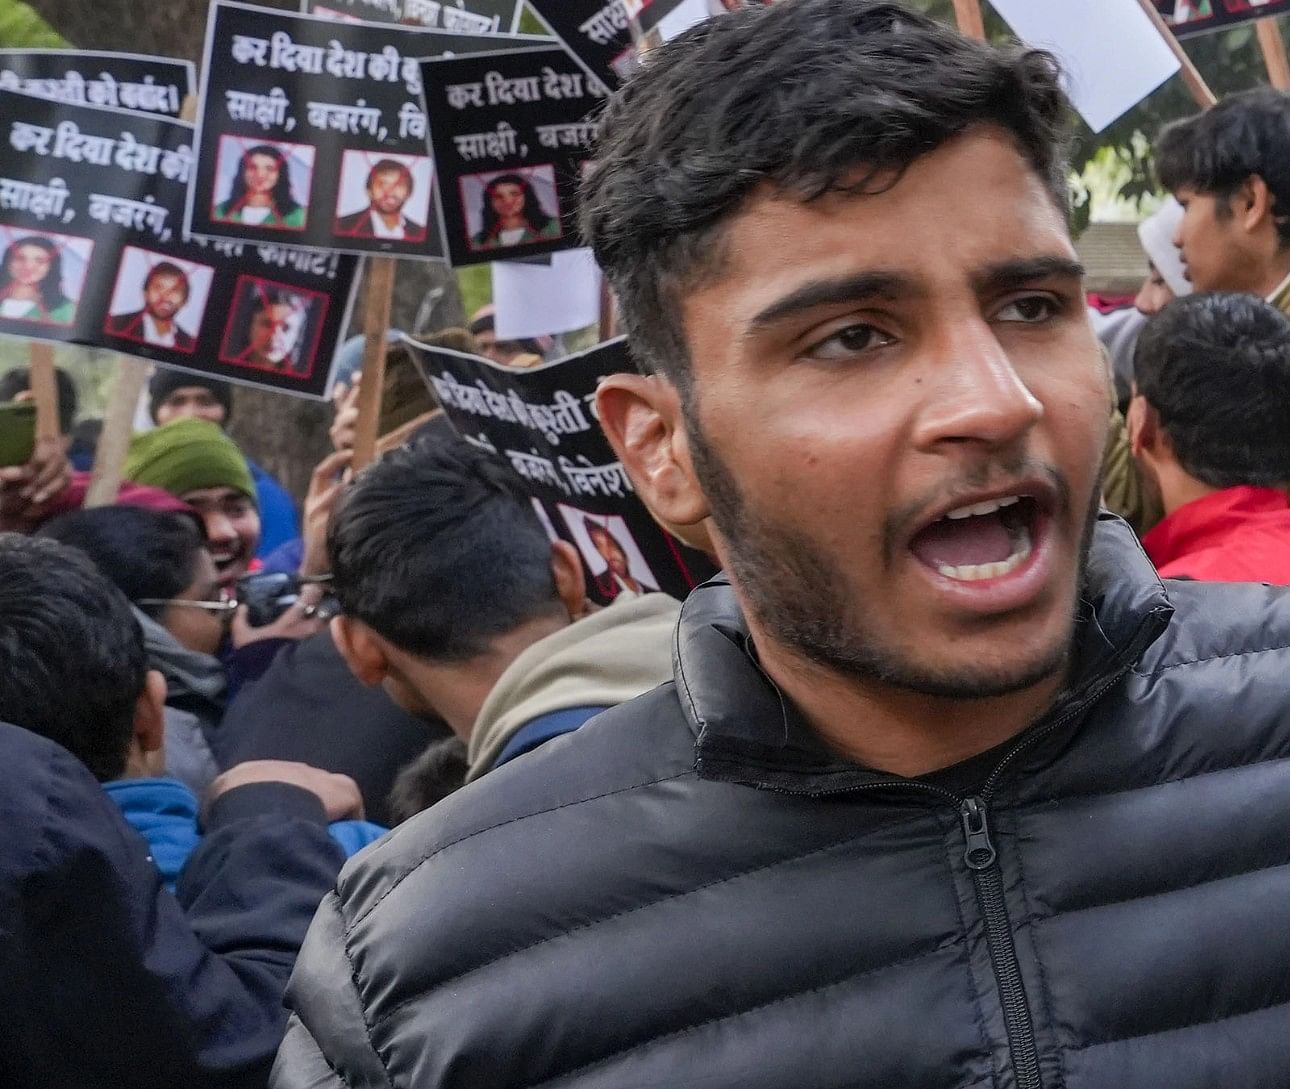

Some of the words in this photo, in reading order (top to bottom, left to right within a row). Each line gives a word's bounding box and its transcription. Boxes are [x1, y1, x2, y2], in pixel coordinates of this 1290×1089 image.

[232, 34, 270, 67] कर
[270, 31, 326, 75] दिया
[326, 39, 368, 79] देश
[368, 44, 400, 83] की
[445, 81, 485, 110] कर
[484, 70, 541, 105] दिया
[541, 66, 584, 100] देश
[9, 120, 54, 157] कर
